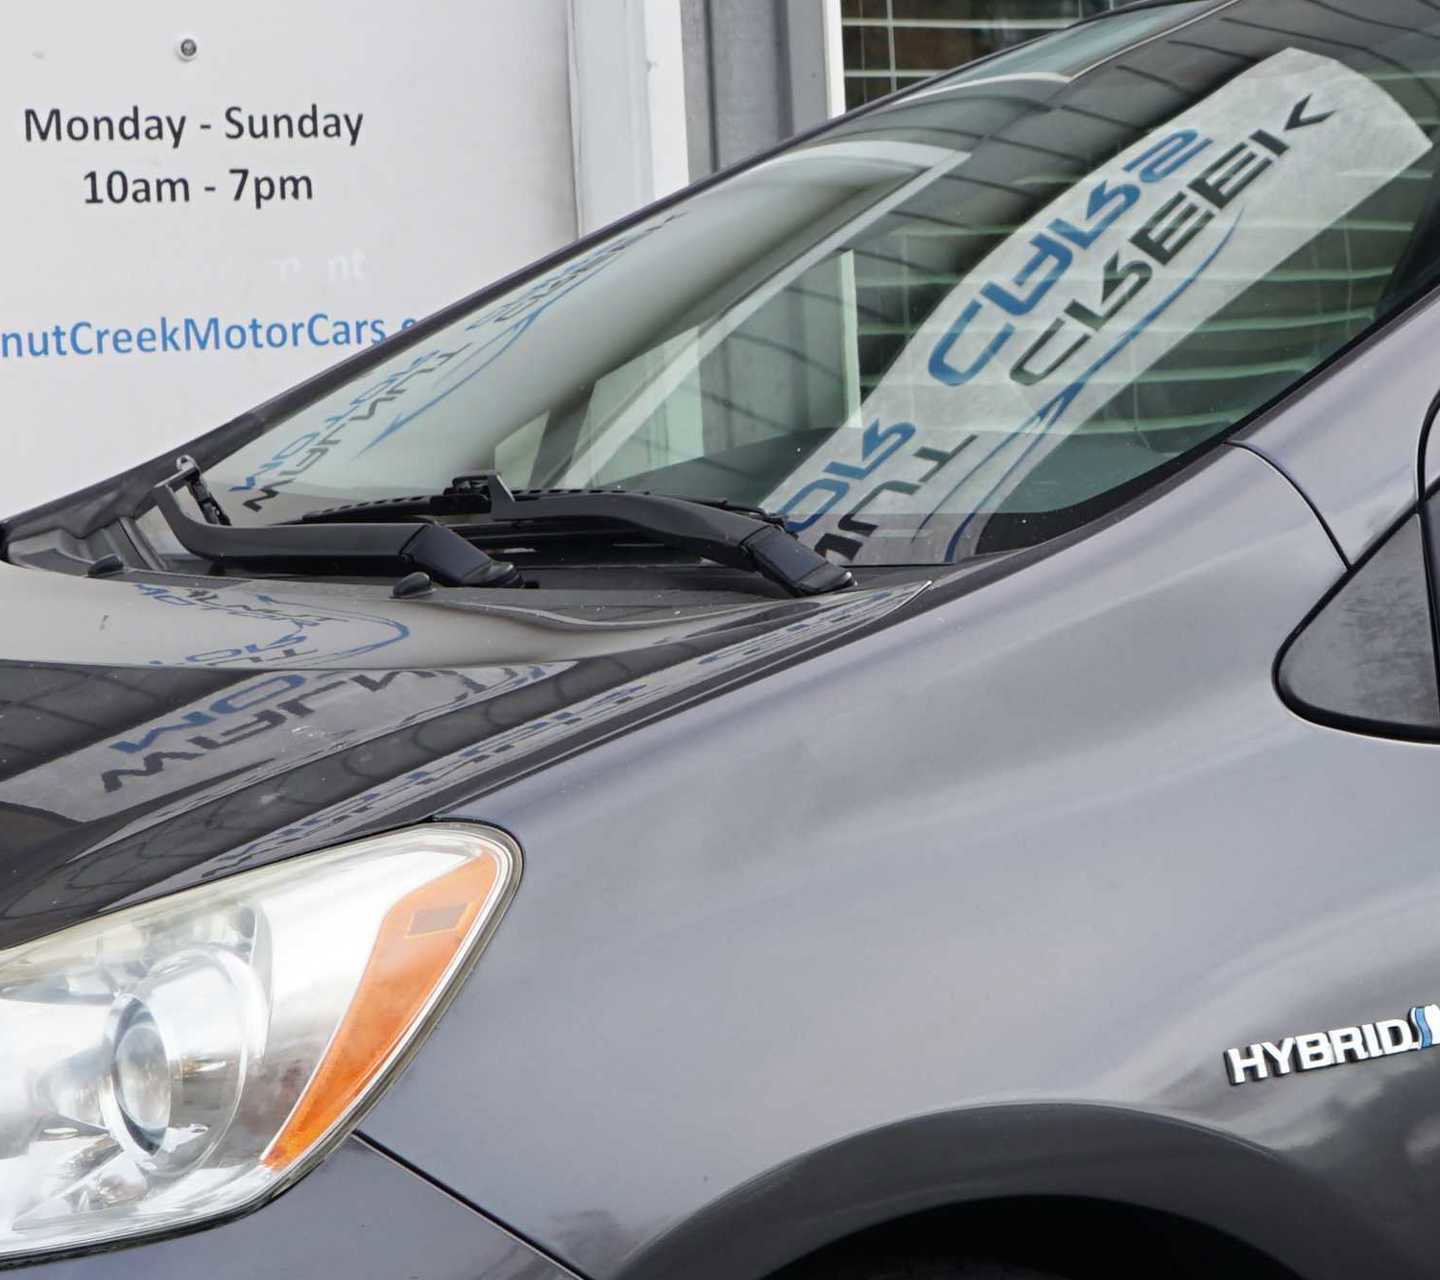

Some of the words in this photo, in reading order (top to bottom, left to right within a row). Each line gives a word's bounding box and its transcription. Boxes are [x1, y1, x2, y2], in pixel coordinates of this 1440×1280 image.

[24, 105, 187, 149] Monday
[224, 103, 364, 147] Sunday
[83, 170, 190, 204] 10am
[228, 168, 313, 210] 7pm
[1226, 1018, 1418, 1086] HYBRID
